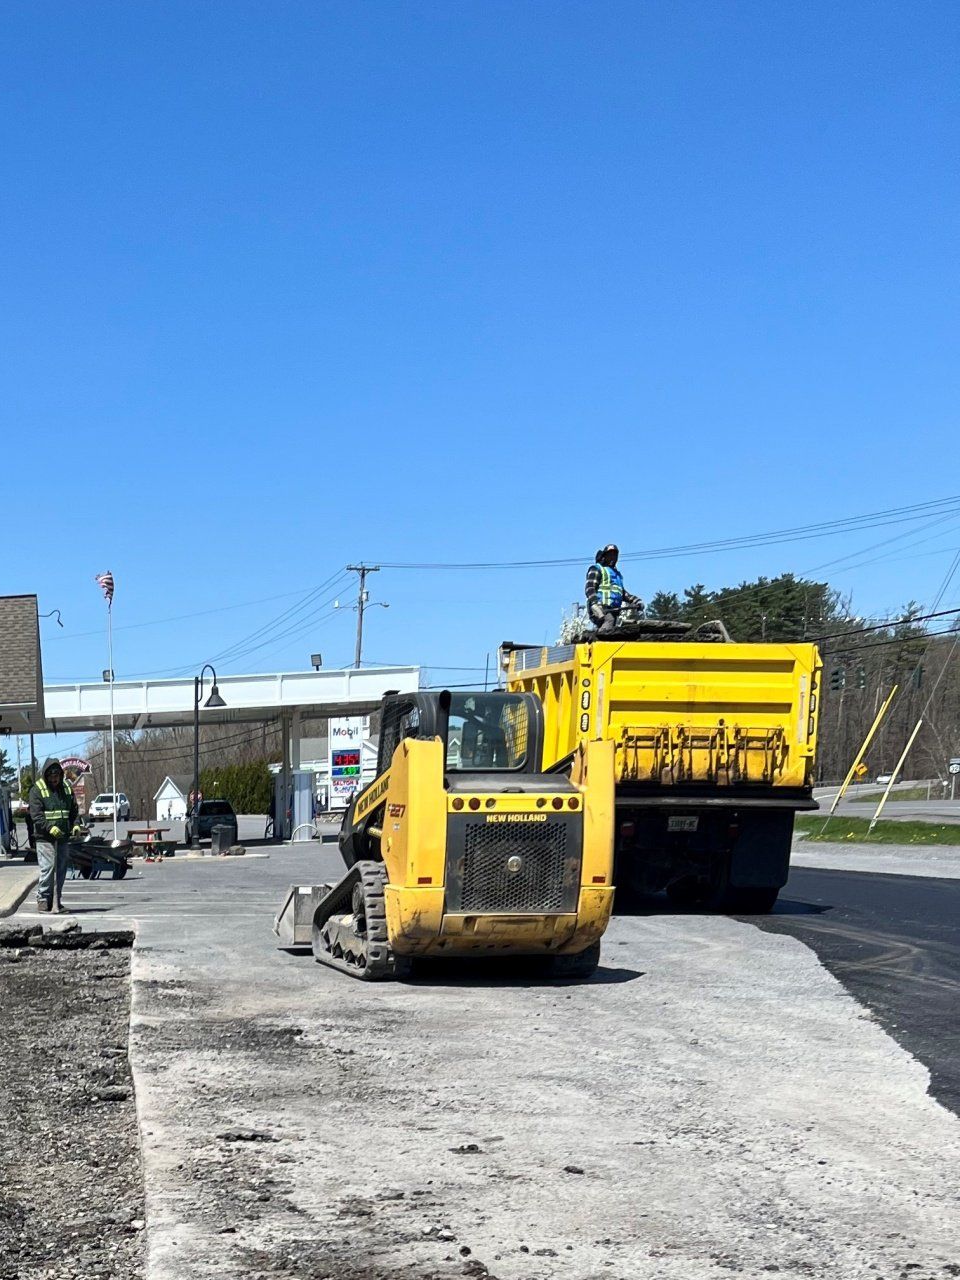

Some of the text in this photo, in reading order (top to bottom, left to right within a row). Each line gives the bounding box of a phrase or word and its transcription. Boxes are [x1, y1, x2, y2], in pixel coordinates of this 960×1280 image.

[332, 727, 359, 737] Mobil
[486, 813, 547, 823] NEW HOLLAND
